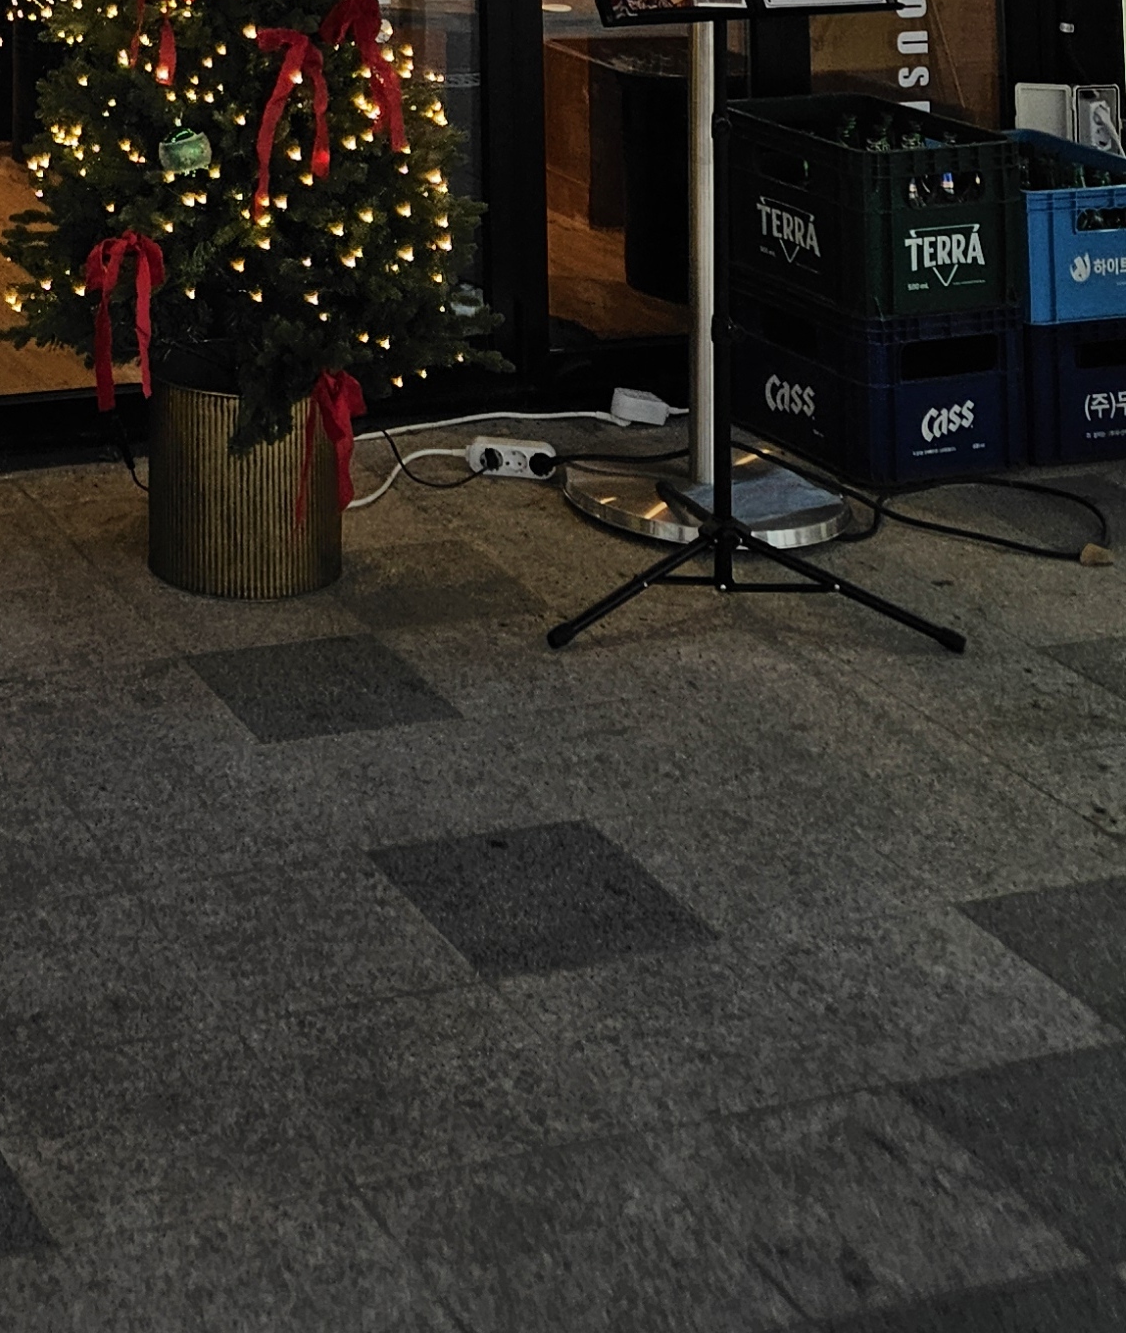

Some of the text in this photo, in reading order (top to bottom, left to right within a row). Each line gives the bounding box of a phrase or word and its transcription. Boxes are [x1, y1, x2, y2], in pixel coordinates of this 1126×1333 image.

[756, 201, 822, 258] TERRA
[904, 230, 986, 272] TERRA
[920, 399, 976, 443] Cass
